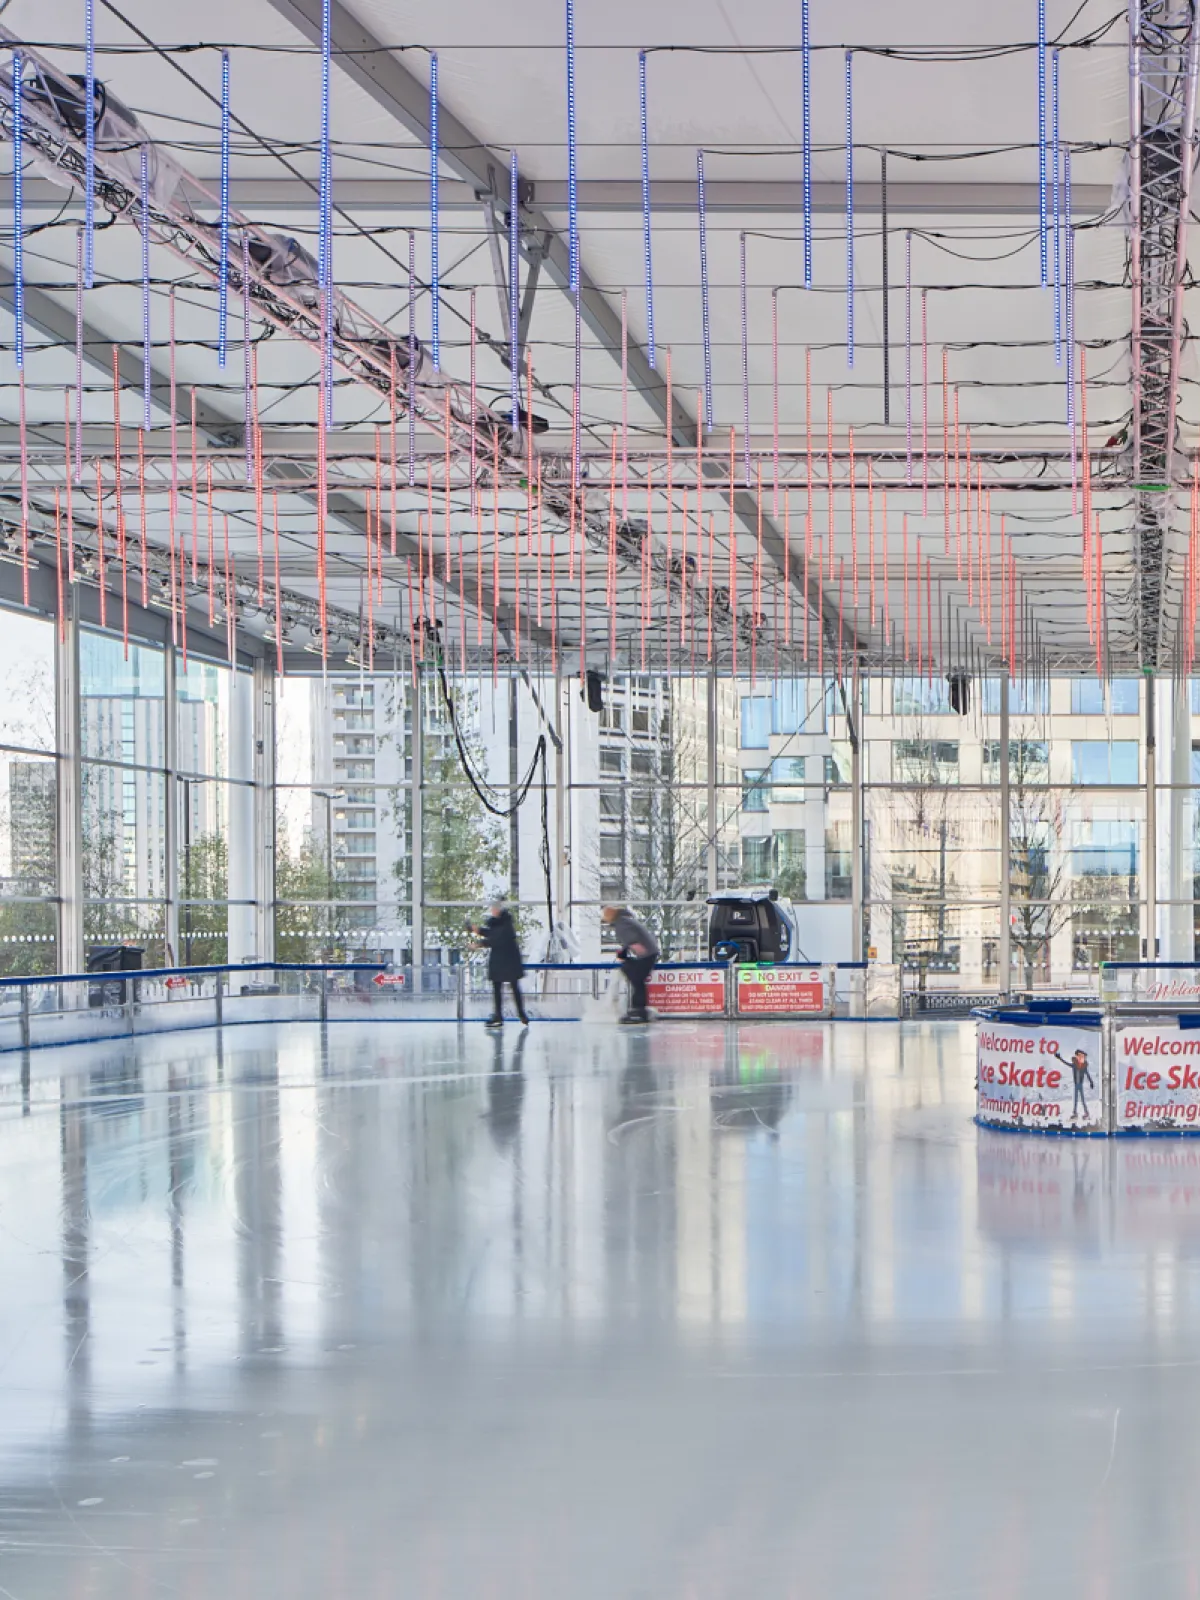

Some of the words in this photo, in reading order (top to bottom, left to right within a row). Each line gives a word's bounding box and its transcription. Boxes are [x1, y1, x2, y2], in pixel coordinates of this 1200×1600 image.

[658, 972, 675, 982] NO
[679, 972, 703, 982] EXIT
[758, 972, 775, 981] NO
[778, 972, 802, 982] EXIT
[766, 984, 797, 992] DANGER
[980, 1031, 1034, 1054] Welcome
[1039, 1036, 1059, 1055] to
[997, 1060, 1062, 1088] Skate
[1125, 1065, 1161, 1091] Ice
